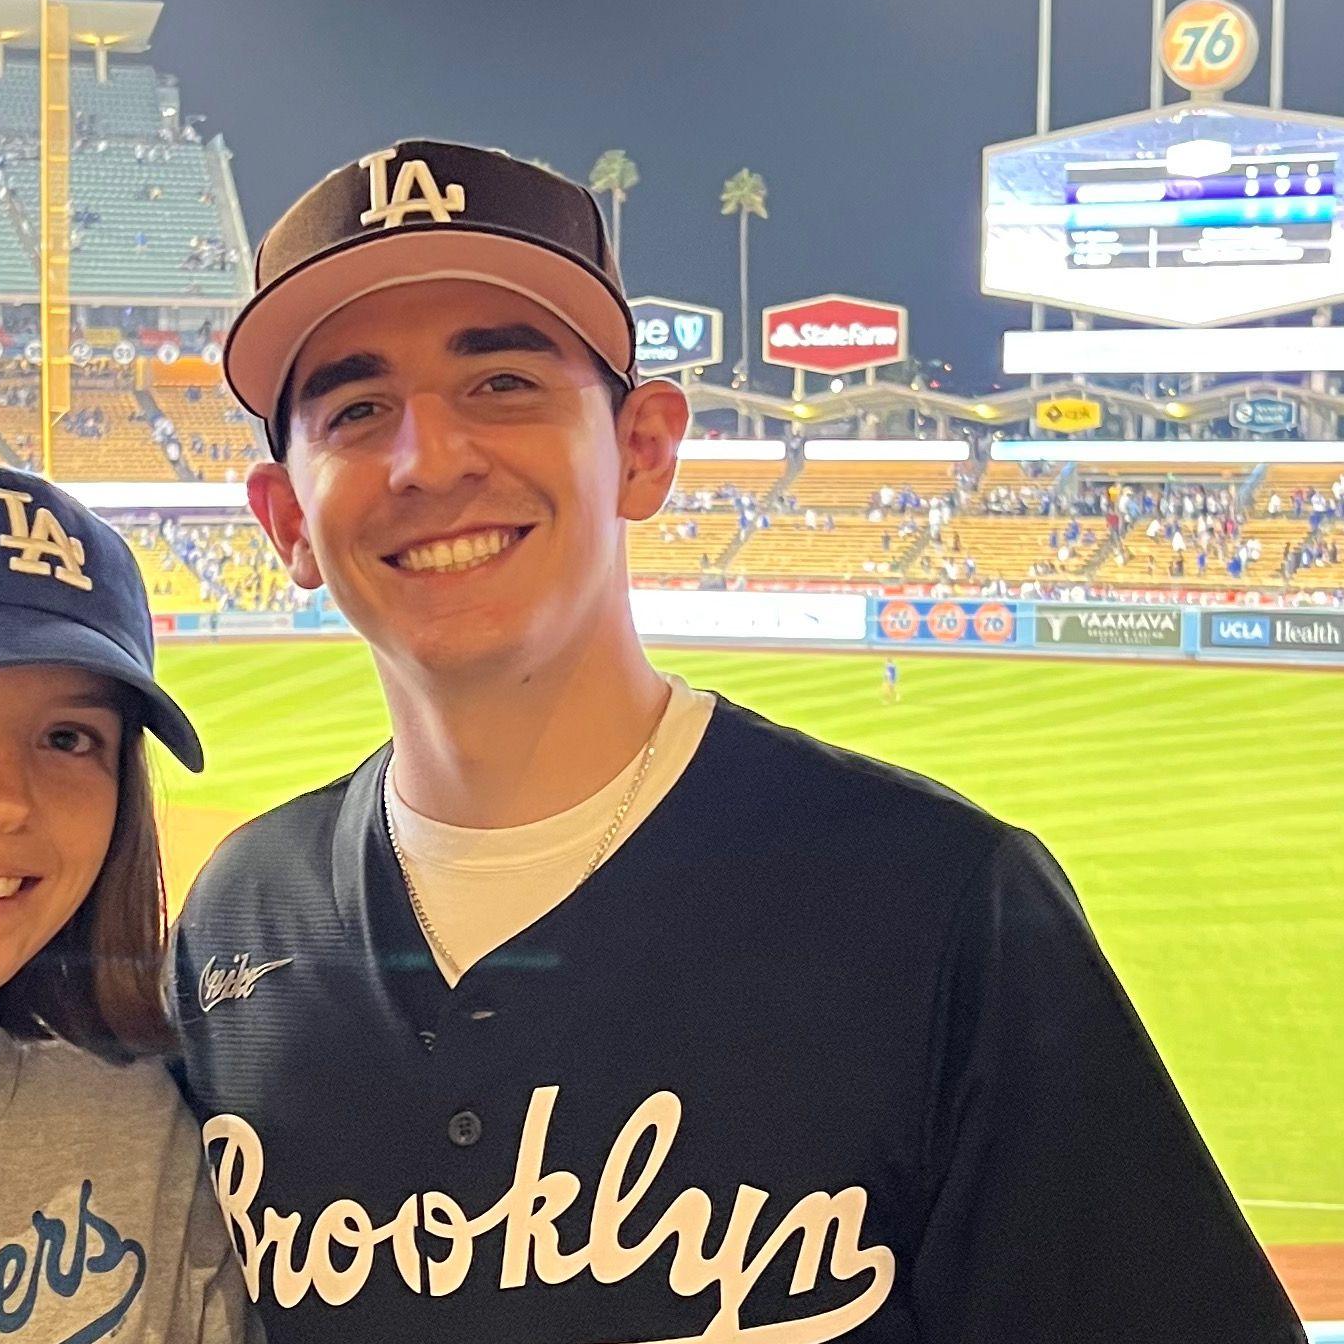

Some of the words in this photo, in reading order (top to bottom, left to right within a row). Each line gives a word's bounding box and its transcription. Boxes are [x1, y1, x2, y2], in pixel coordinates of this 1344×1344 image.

[1177, 19, 1235, 66] 76
[359, 148, 465, 229] LA
[1219, 621, 1263, 640] UCLA
[1275, 620, 1340, 645] Health
